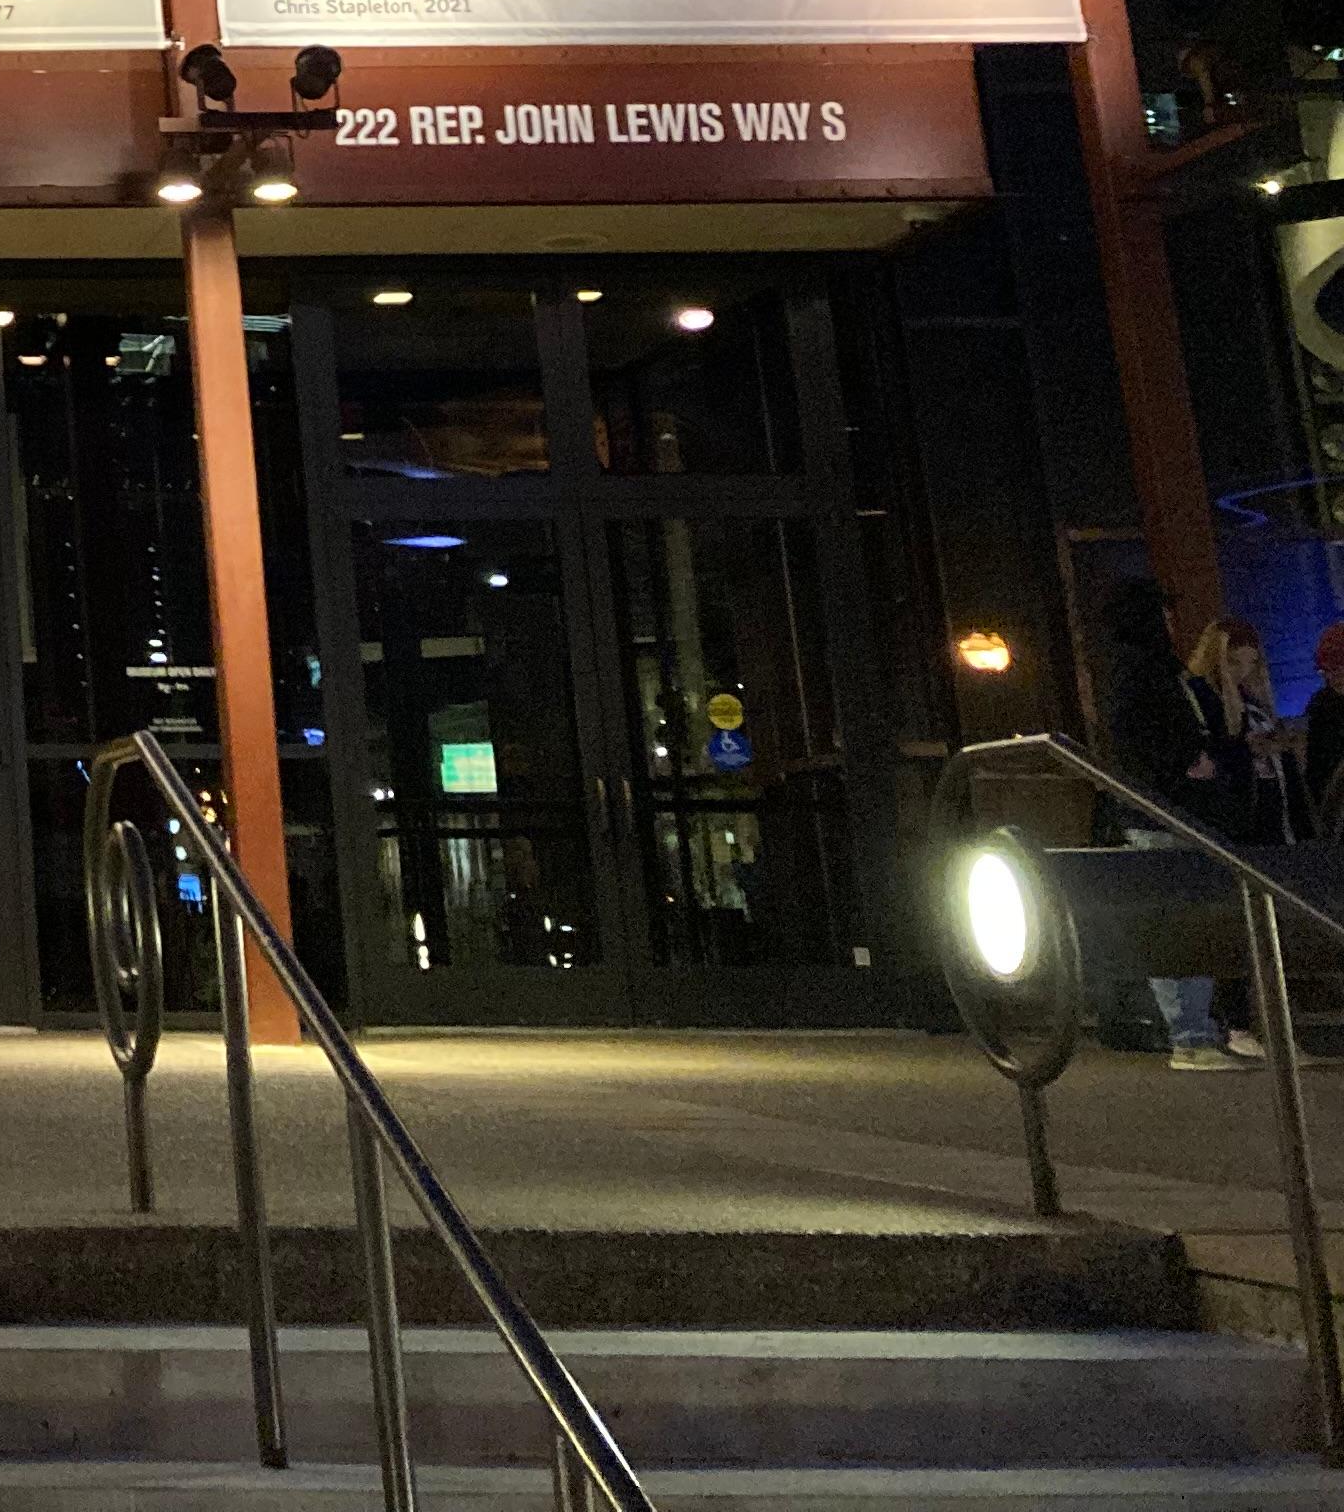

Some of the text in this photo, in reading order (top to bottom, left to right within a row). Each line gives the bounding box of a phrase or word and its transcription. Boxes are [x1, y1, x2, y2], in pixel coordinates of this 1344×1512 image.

[274, 0, 320, 14] Chris
[336, 101, 845, 145] 222 REP. JOHN LEWIS WAY S
